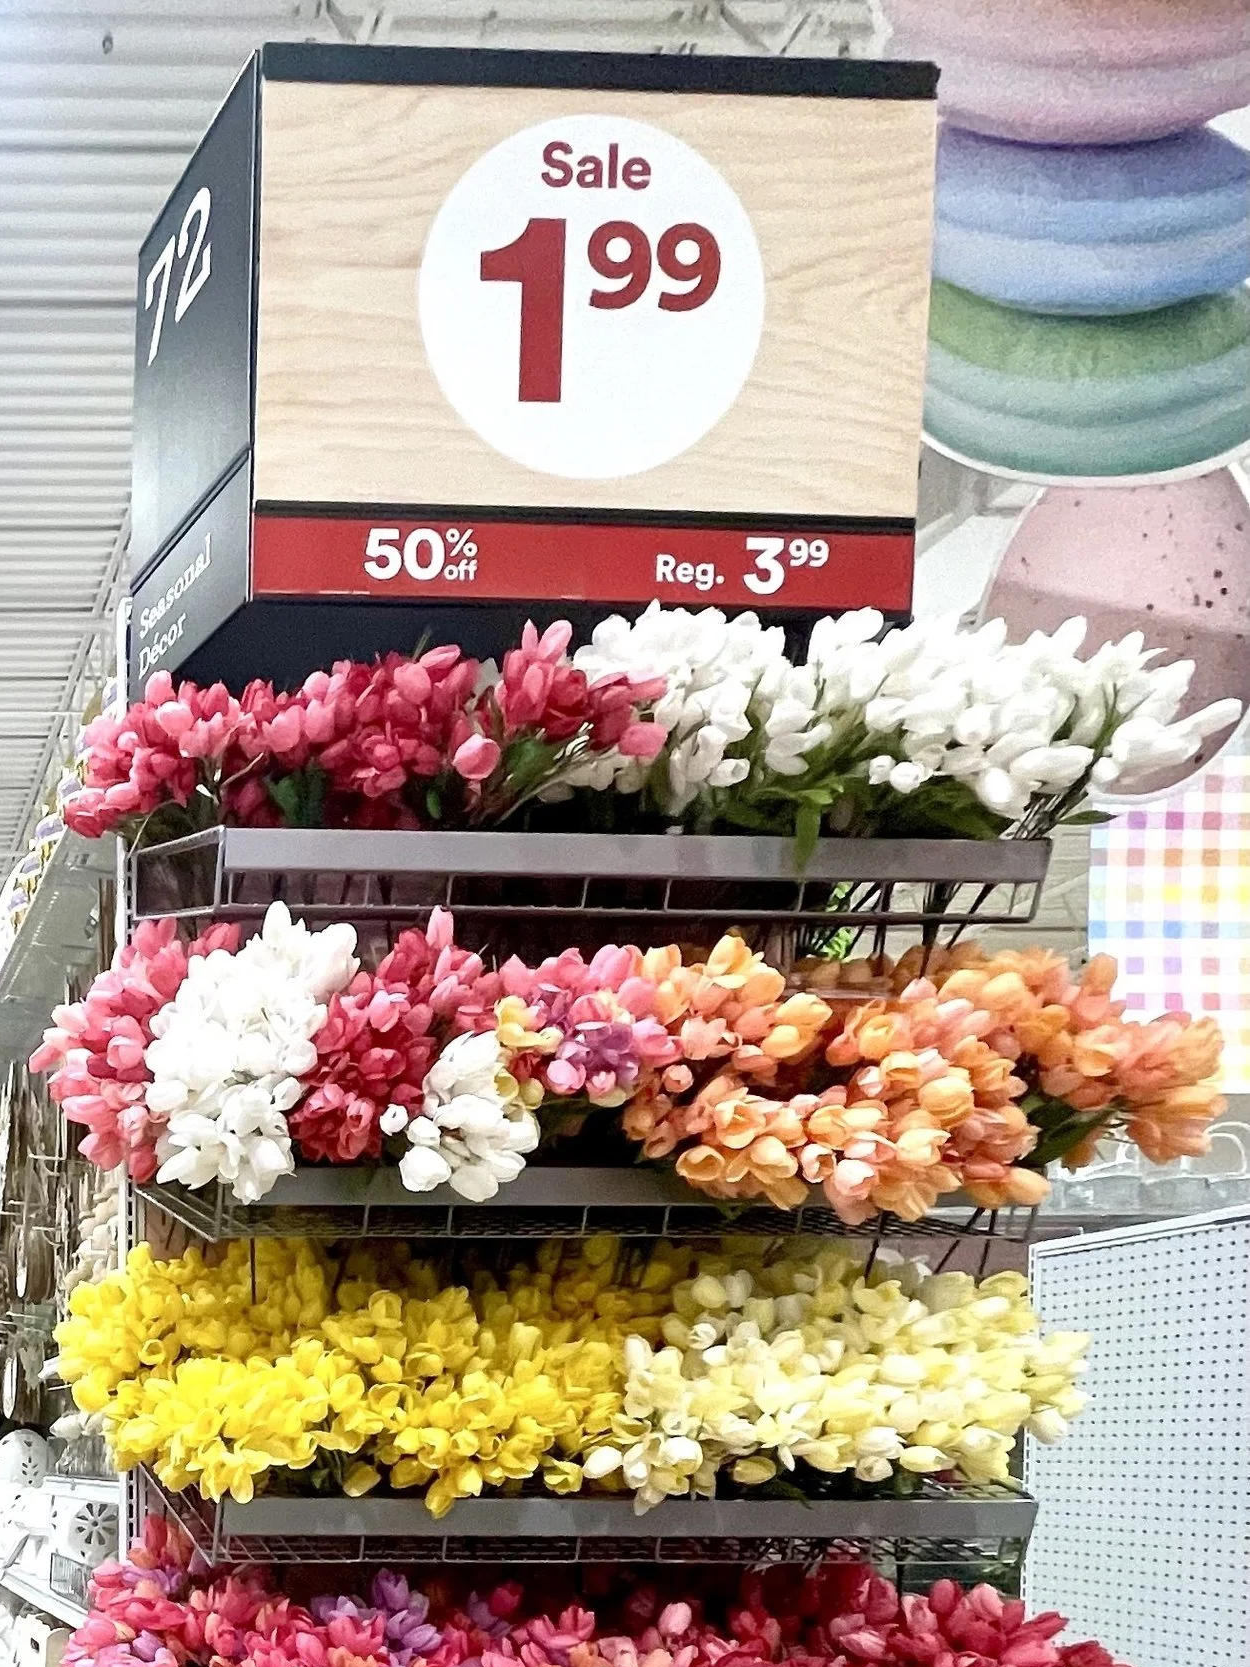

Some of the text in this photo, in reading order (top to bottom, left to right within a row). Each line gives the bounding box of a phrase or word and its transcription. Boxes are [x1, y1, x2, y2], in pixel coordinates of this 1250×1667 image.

[541, 141, 652, 191] Sale
[145, 186, 213, 366] 72
[140, 533, 211, 639] Seasonal
[444, 557, 478, 582] off
[656, 553, 725, 587] Reg.
[138, 612, 186, 680] Décor
